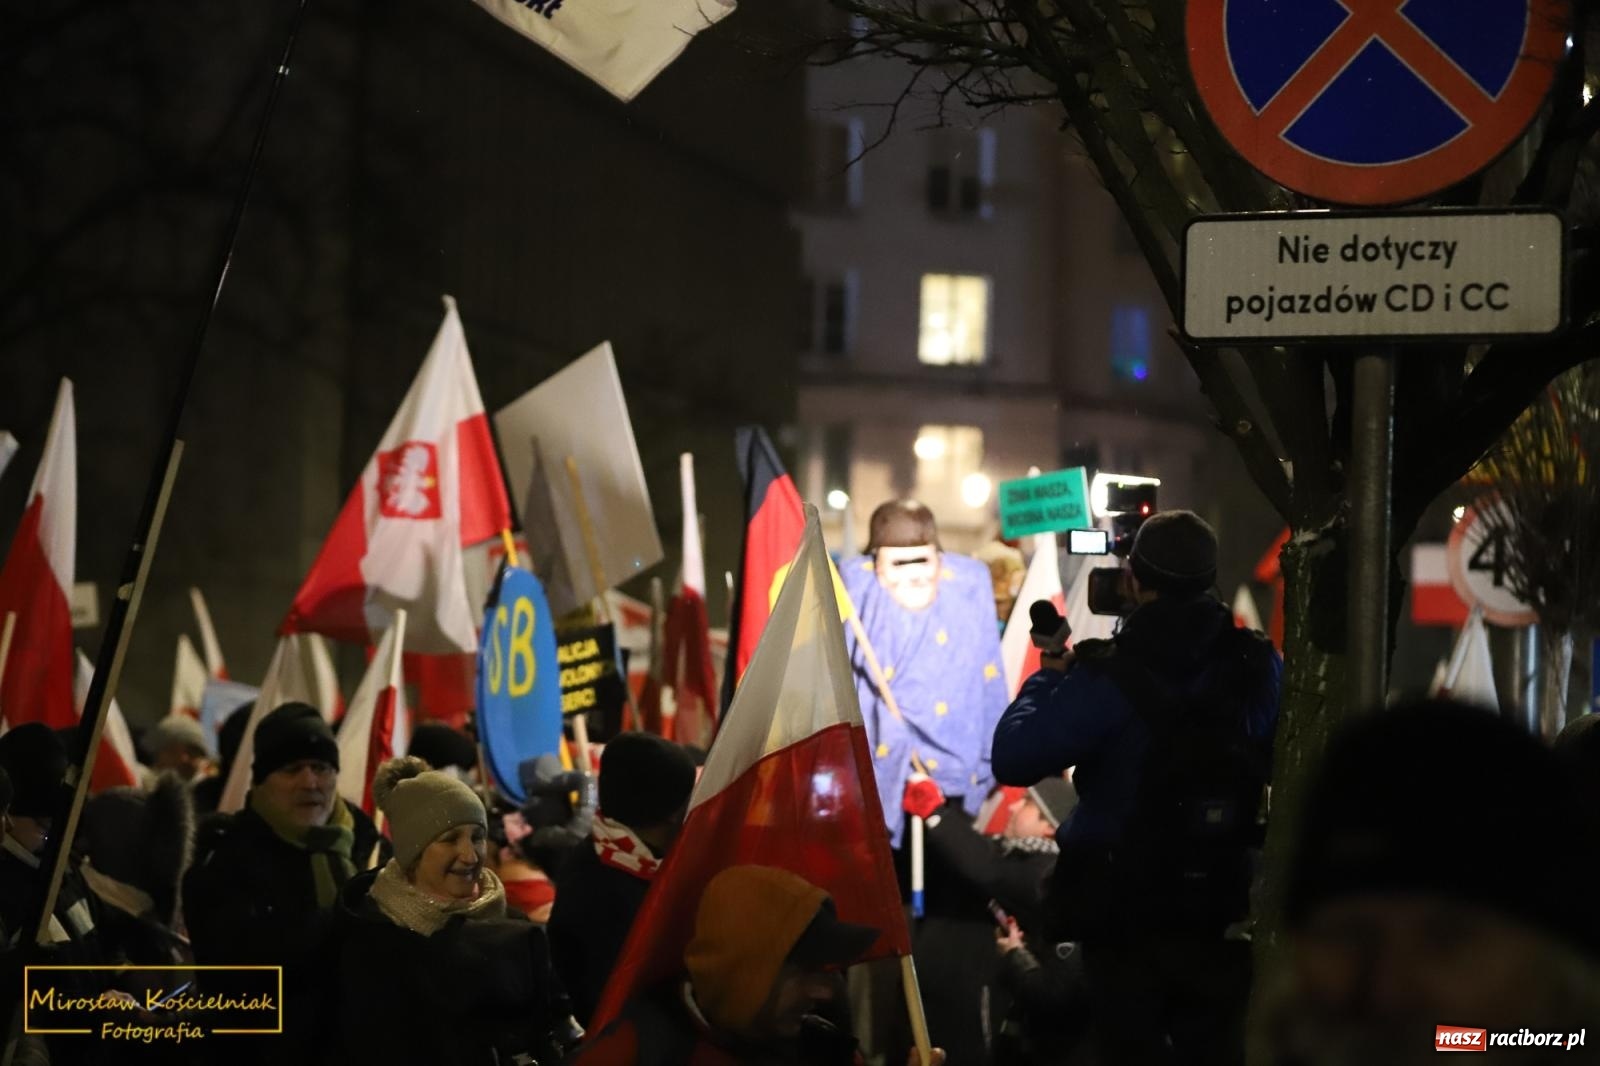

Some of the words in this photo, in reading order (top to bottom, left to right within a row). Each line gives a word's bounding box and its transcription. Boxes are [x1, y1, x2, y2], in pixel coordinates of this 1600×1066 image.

[1278, 234, 1330, 264] Nie
[1340, 233, 1458, 270] dotyczy
[1226, 284, 1377, 324] pojazdów
[1384, 283, 1434, 312] CD
[1444, 283, 1451, 311] i
[1460, 282, 1510, 311] CC
[486, 596, 537, 698] SB
